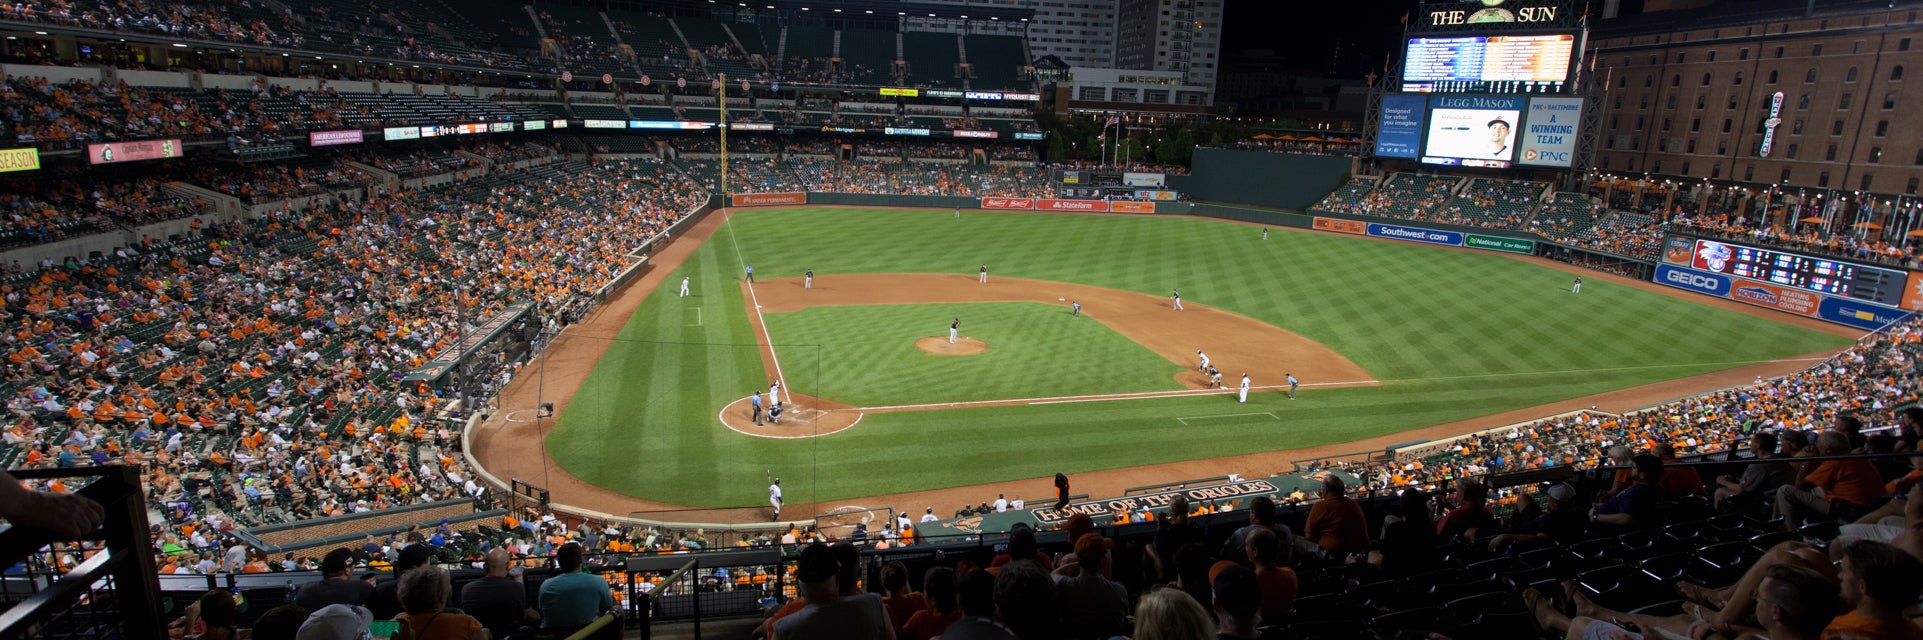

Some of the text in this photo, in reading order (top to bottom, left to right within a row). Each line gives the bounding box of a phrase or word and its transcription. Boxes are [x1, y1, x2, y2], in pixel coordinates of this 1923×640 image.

[1431, 6, 1557, 25] THE SUN
[1440, 97, 1514, 108] LEGG MASON
[1550, 114, 1556, 122] A
[1531, 124, 1572, 134] WINNING
[1537, 136, 1562, 144] TEAM
[0, 151, 36, 169] SEASON
[1540, 151, 1568, 161] PNC
[1476, 238, 1502, 246] National
[1667, 270, 1718, 290] GEICO
[1736, 289, 1778, 304] HORIZON
[1782, 290, 1810, 300] HEATING
[1779, 302, 1808, 312] COOLING
[1780, 296, 1814, 308] PLUMBING
[1036, 480, 1273, 520] HOME OF TH ORIOLES
